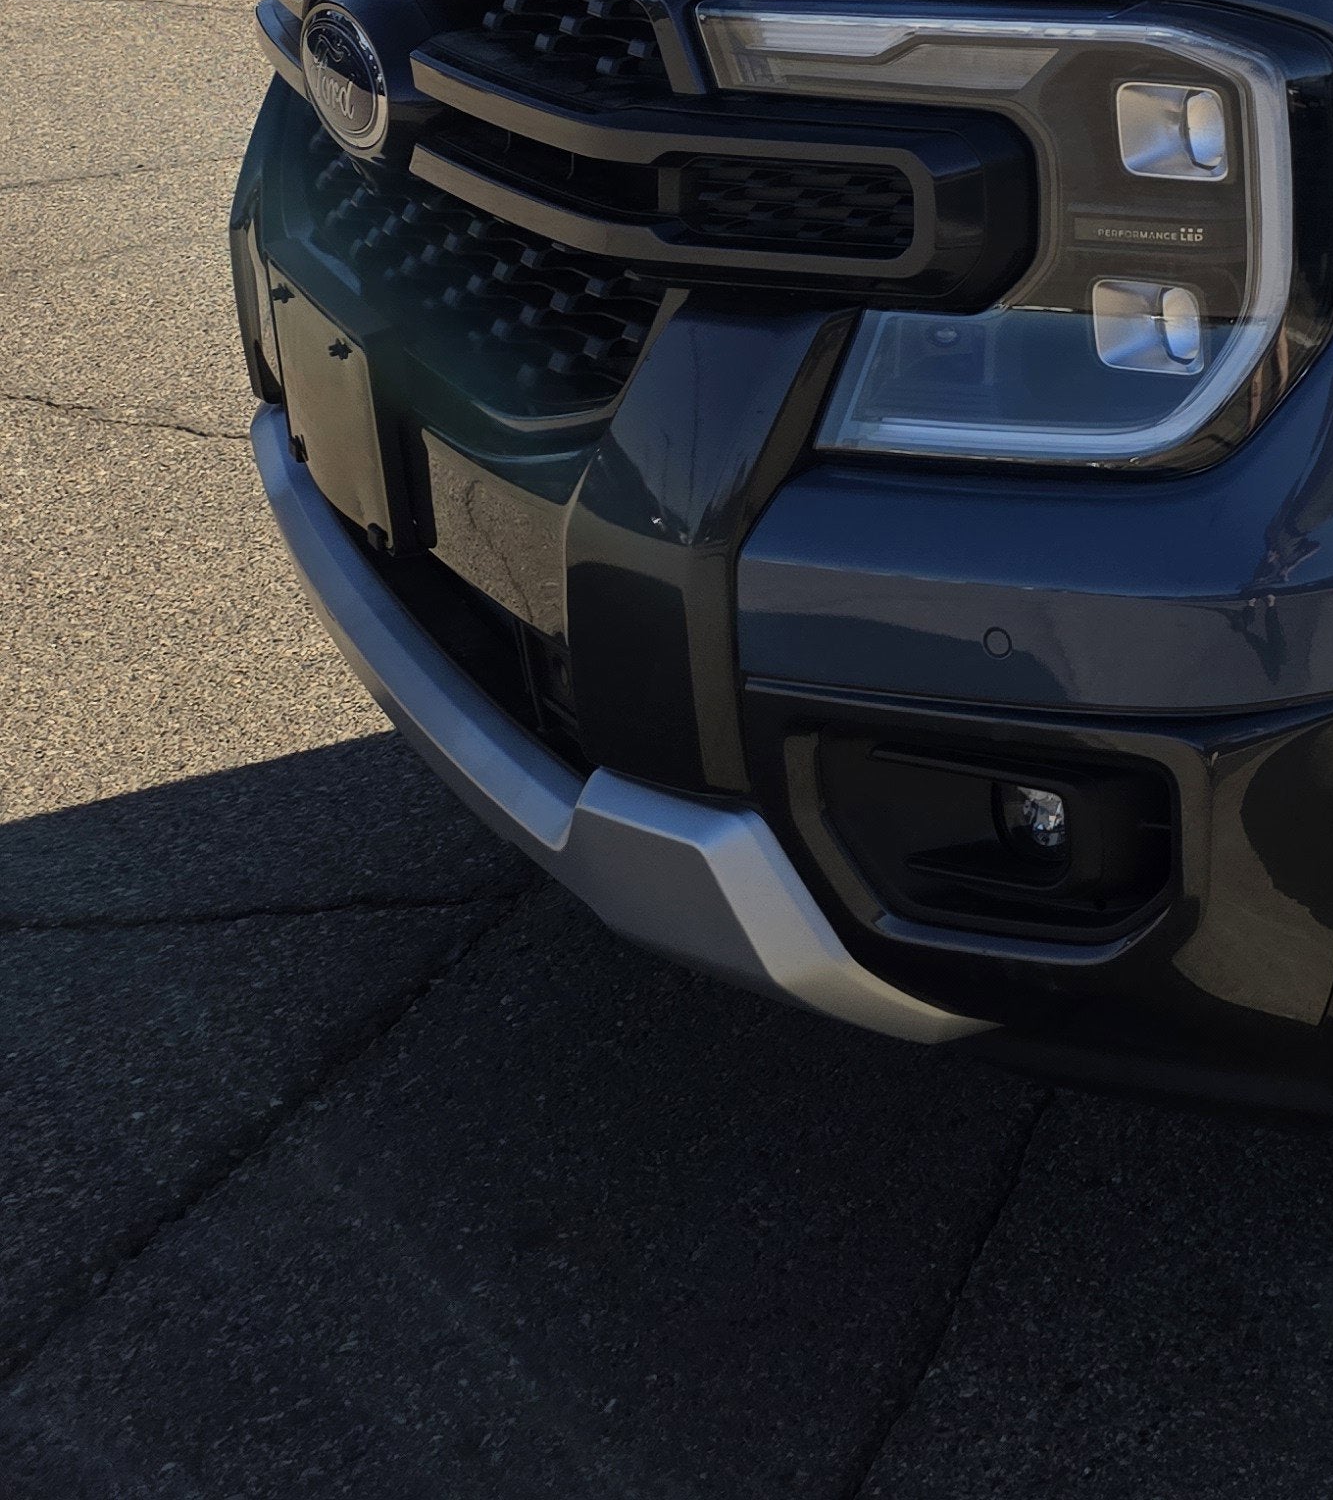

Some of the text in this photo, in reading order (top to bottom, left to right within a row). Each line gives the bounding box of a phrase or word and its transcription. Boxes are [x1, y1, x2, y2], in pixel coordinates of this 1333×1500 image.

[310, 33, 355, 120] Ford
[1097, 228, 1203, 241] PERFORMANCE LED
